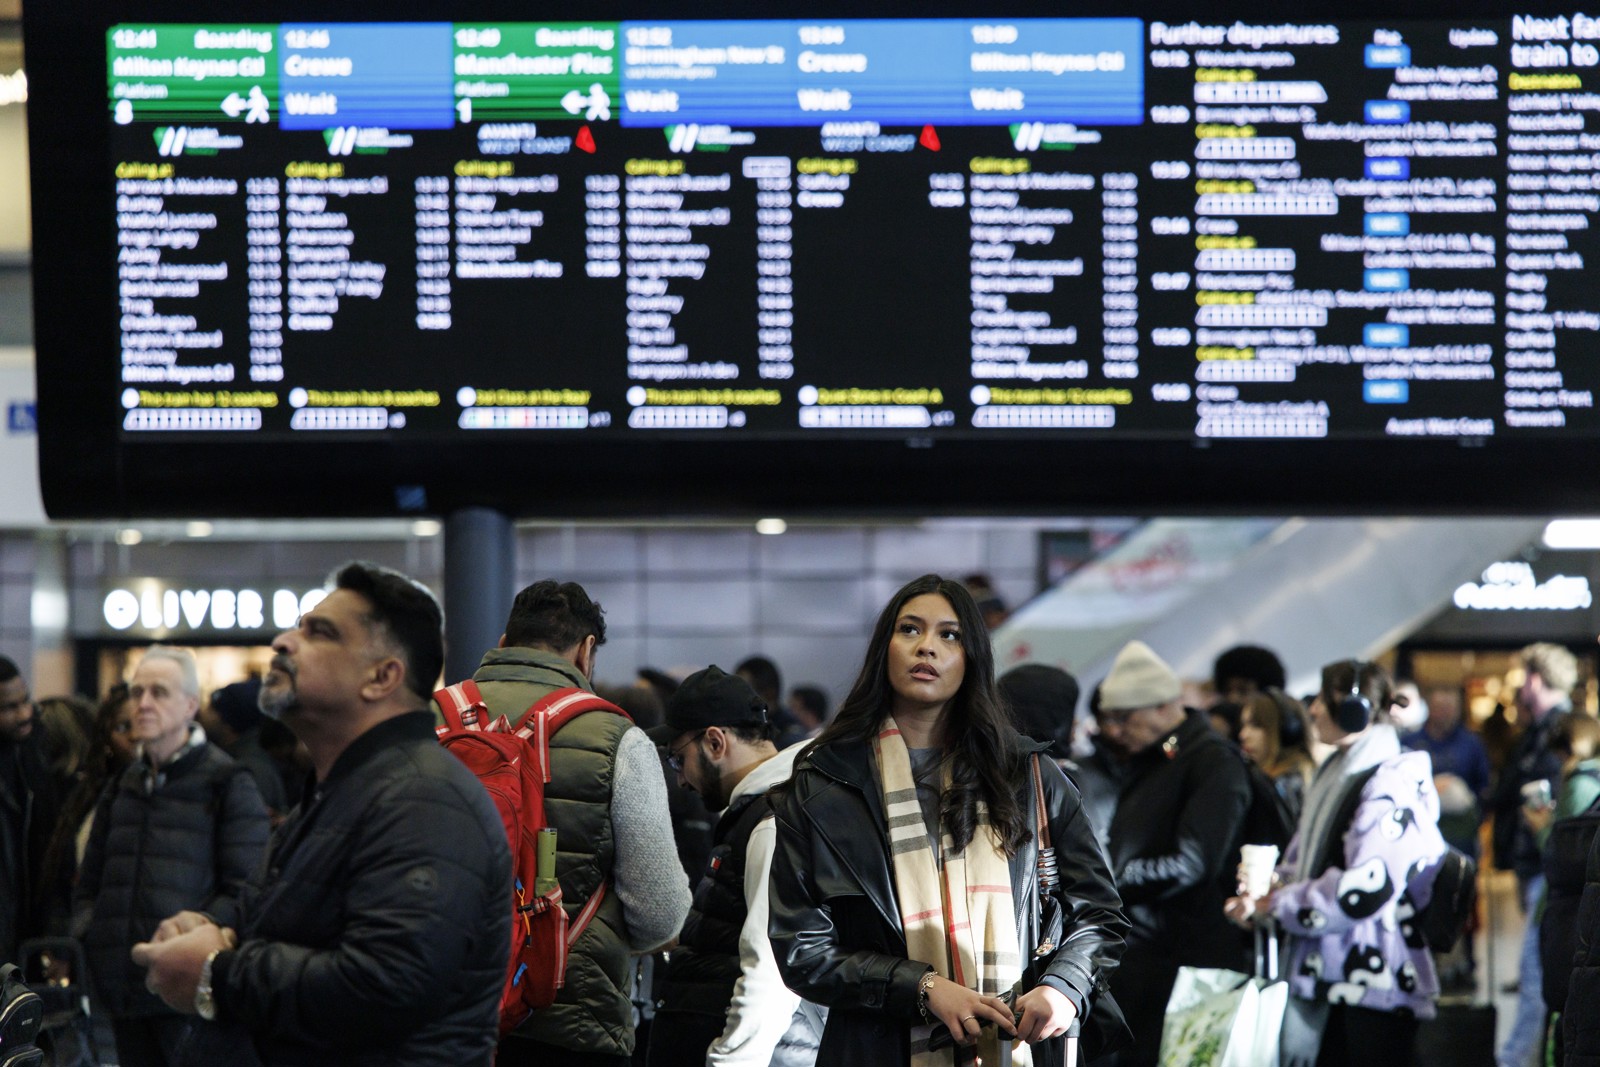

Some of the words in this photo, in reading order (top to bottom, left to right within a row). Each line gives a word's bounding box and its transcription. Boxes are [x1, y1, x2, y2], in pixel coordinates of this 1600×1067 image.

[535, 27, 615, 50] Boarding
[1150, 21, 1227, 45] Further
[1227, 21, 1339, 48] departures
[1512, 14, 1570, 40] Next
[194, 29, 272, 53] Boarding
[284, 54, 353, 77] Crewe
[454, 53, 570, 75] Manchester
[625, 46, 727, 68] Birmingham
[727, 46, 765, 64] New
[765, 45, 785, 64] St
[798, 51, 867, 72] Crewe
[970, 52, 1031, 72] Milton
[1031, 52, 1097, 75] Keynes
[1511, 41, 1568, 67] train
[1571, 42, 1600, 67] to
[113, 56, 172, 77] Milton
[173, 56, 238, 80] Keynes
[113, 82, 168, 99] Platform
[454, 81, 509, 97] Platform
[625, 89, 679, 112] Wait
[797, 88, 851, 111] Wait
[970, 87, 1024, 111] Wait
[284, 92, 338, 115] Wait
[455, 98, 472, 123] 1
[104, 589, 263, 629] OLIVER
